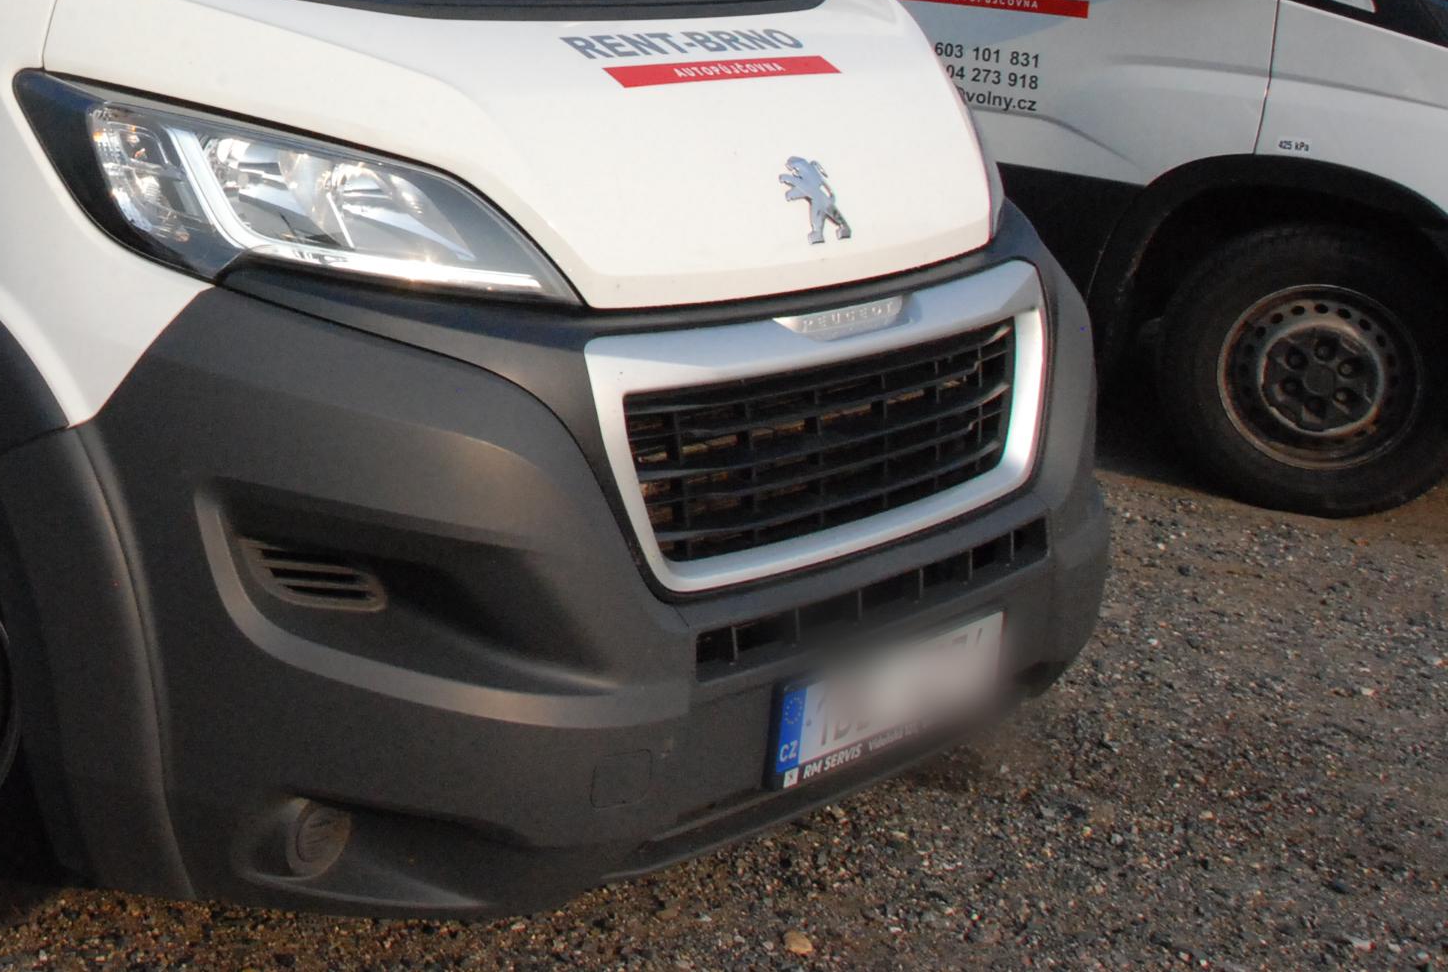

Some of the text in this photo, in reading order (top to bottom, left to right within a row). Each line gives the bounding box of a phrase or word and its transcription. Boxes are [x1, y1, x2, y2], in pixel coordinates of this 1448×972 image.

[559, 28, 804, 59] RENT-BRNO
[934, 42, 1039, 68] 603 101 831
[673, 62, 786, 78] AUTOPŮJČOVNA
[946, 64, 1038, 90] 04 273 918
[779, 739, 798, 762] CZ
[824, 742, 863, 771] SERVIS
